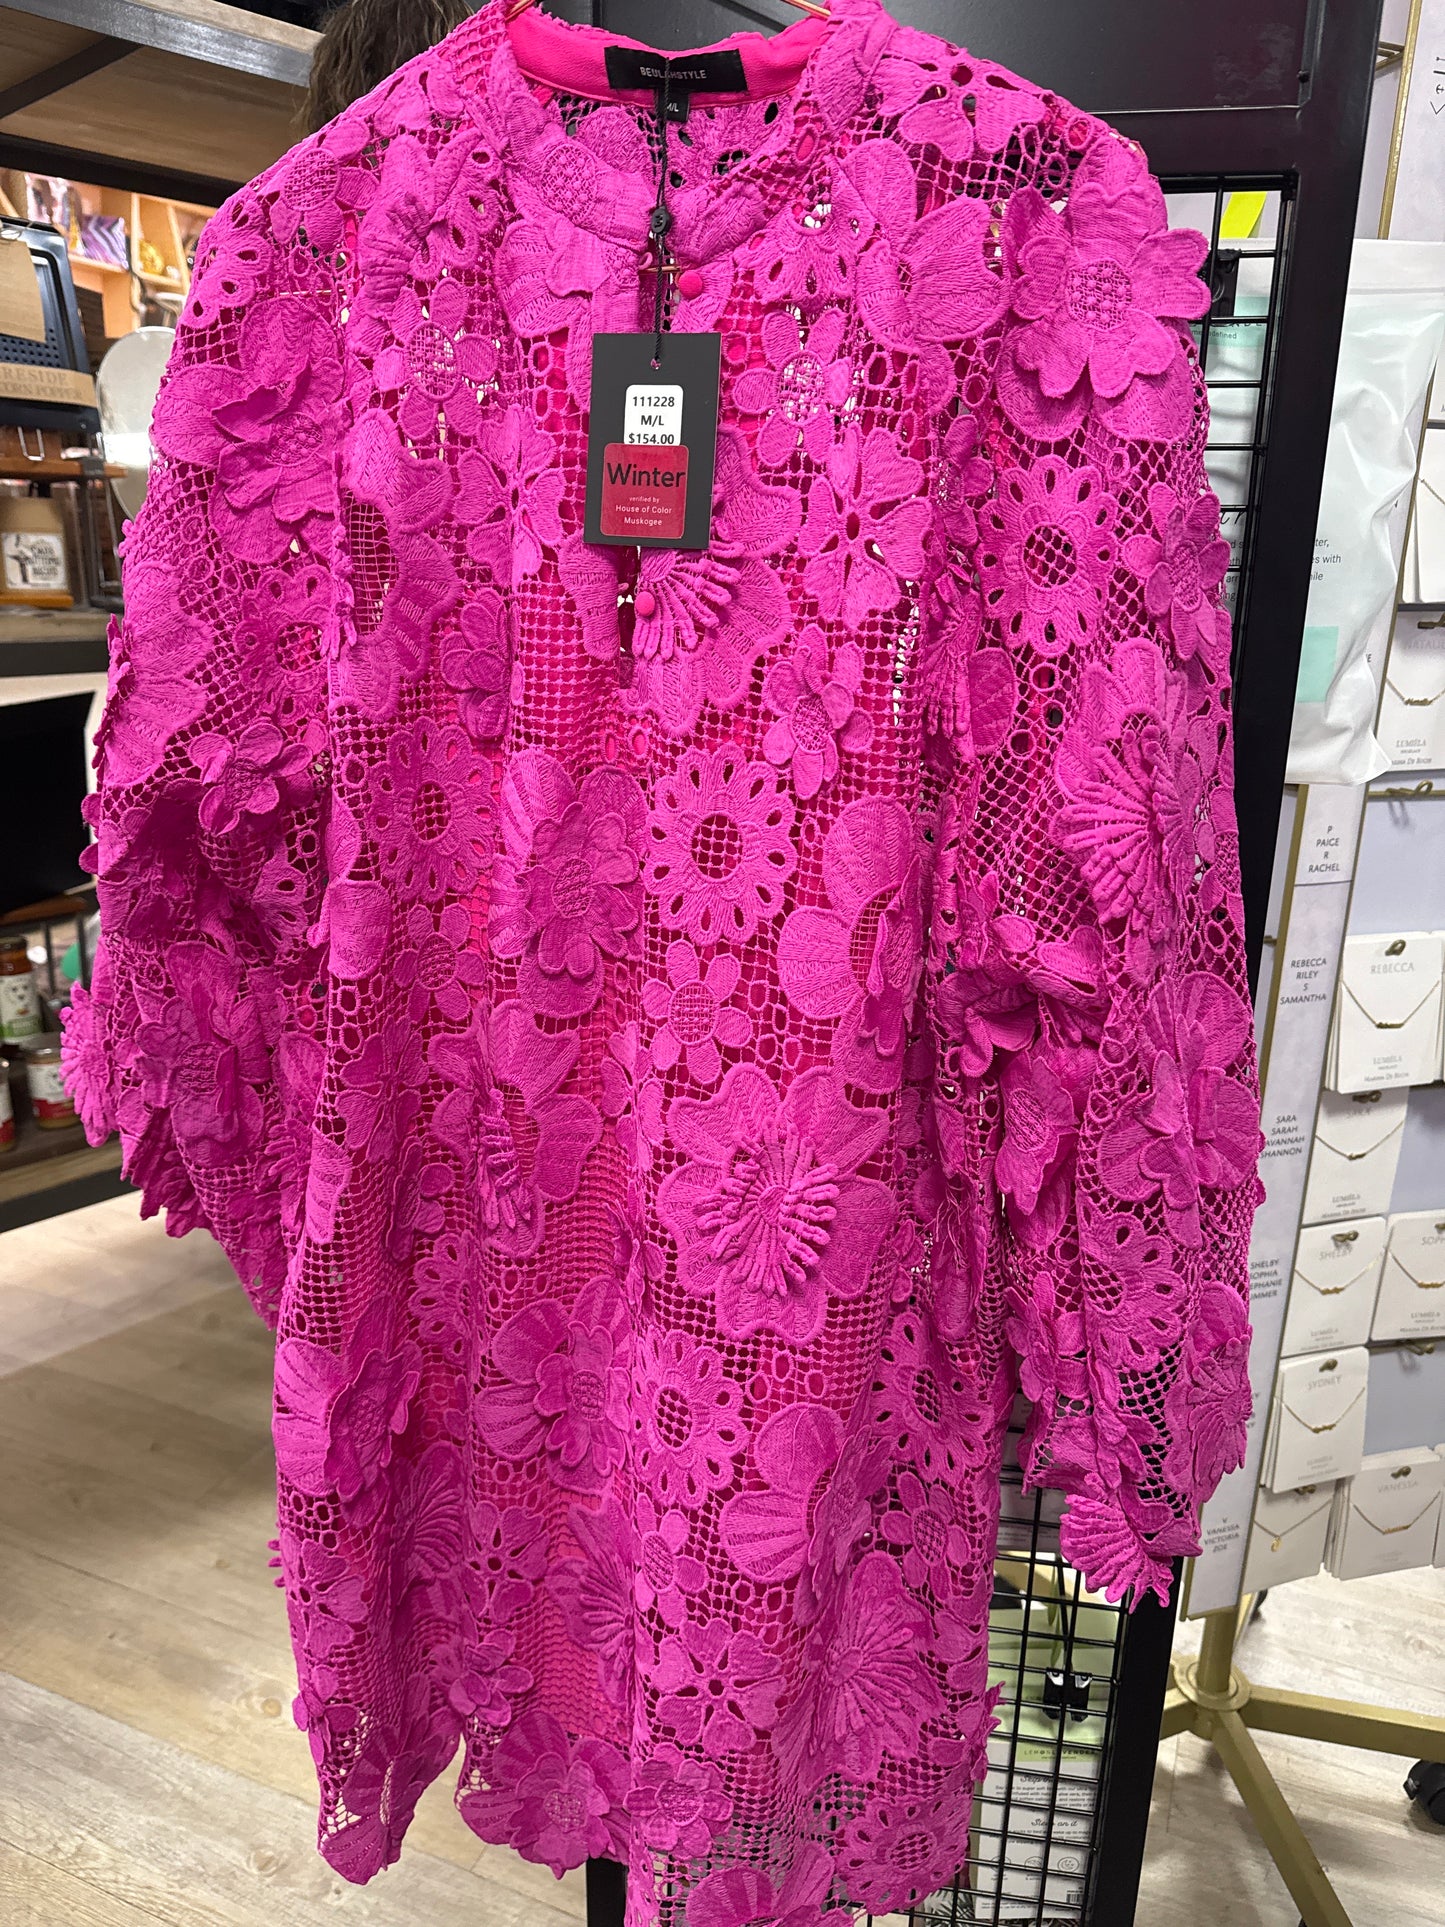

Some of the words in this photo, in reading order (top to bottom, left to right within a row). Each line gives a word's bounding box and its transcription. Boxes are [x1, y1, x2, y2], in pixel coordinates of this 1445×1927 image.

[633, 396, 675, 407] 111228
[641, 415, 664, 427] M/L
[629, 433, 675, 445] $154.00
[607, 462, 686, 488] Winter
[615, 504, 639, 513] House
[641, 505, 650, 513] of
[652, 506, 672, 514] Color
[624, 516, 663, 526] Muskogee
[1323, 554, 1341, 563] with
[1327, 825, 1333, 834] P
[1323, 851, 1329, 860] R
[1308, 863, 1341, 873] RACHEL
[1291, 957, 1327, 968] REBECCA
[1370, 962, 1415, 975] REBECCA
[1296, 970, 1319, 980] RILEY
[1303, 982, 1309, 991] S
[1280, 993, 1327, 1005] SAMANTHA
[1275, 1114, 1297, 1124] SARA
[1271, 1126, 1298, 1136] SARAH
[1266, 1136, 1305, 1147] AVANNAH
[1250, 1258, 1280, 1270] SHELBY
[1305, 1374, 1343, 1391] SYDNEY
[1207, 1523, 1240, 1535] VANESSA
[1204, 1532, 1240, 1545] VICTORIA
